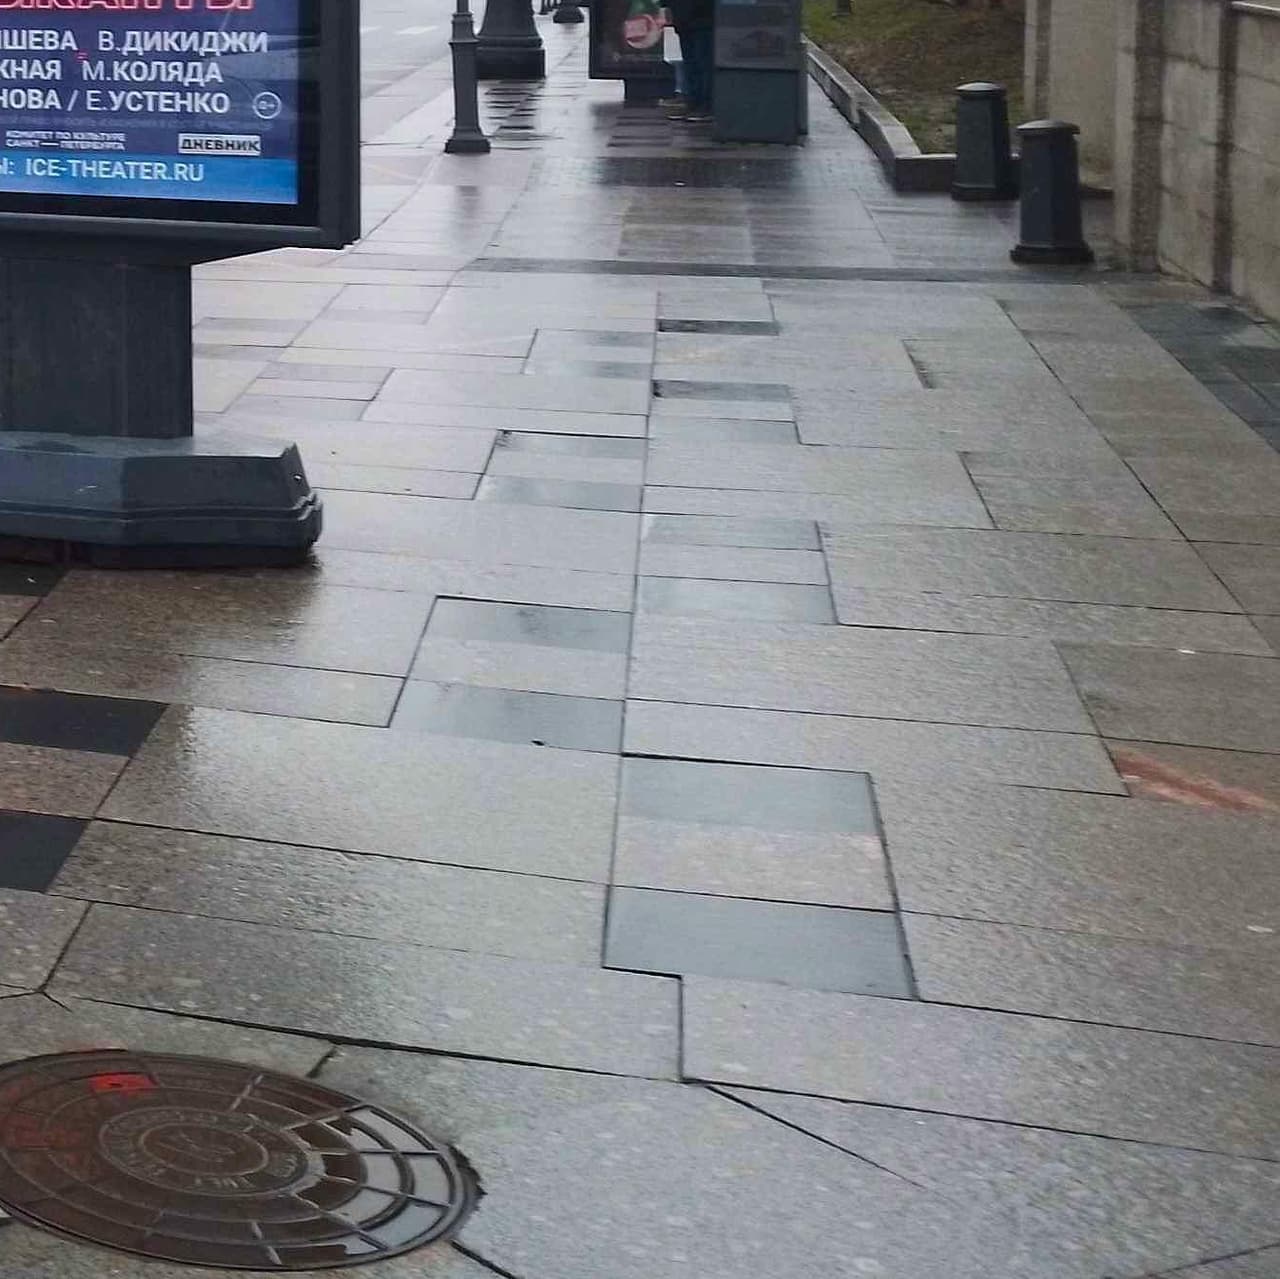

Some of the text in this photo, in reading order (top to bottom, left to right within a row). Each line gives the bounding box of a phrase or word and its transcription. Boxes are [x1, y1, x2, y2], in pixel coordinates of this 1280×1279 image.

[98, 30, 268, 56] В.ДИКИДЖИ
[82, 60, 224, 87] М.КОЛЯДА
[86, 90, 230, 113] Е.УСТЕНКО
[181, 138, 260, 152] ДНЕВНИК
[25, 158, 204, 182] ICE-THEATER.RU
